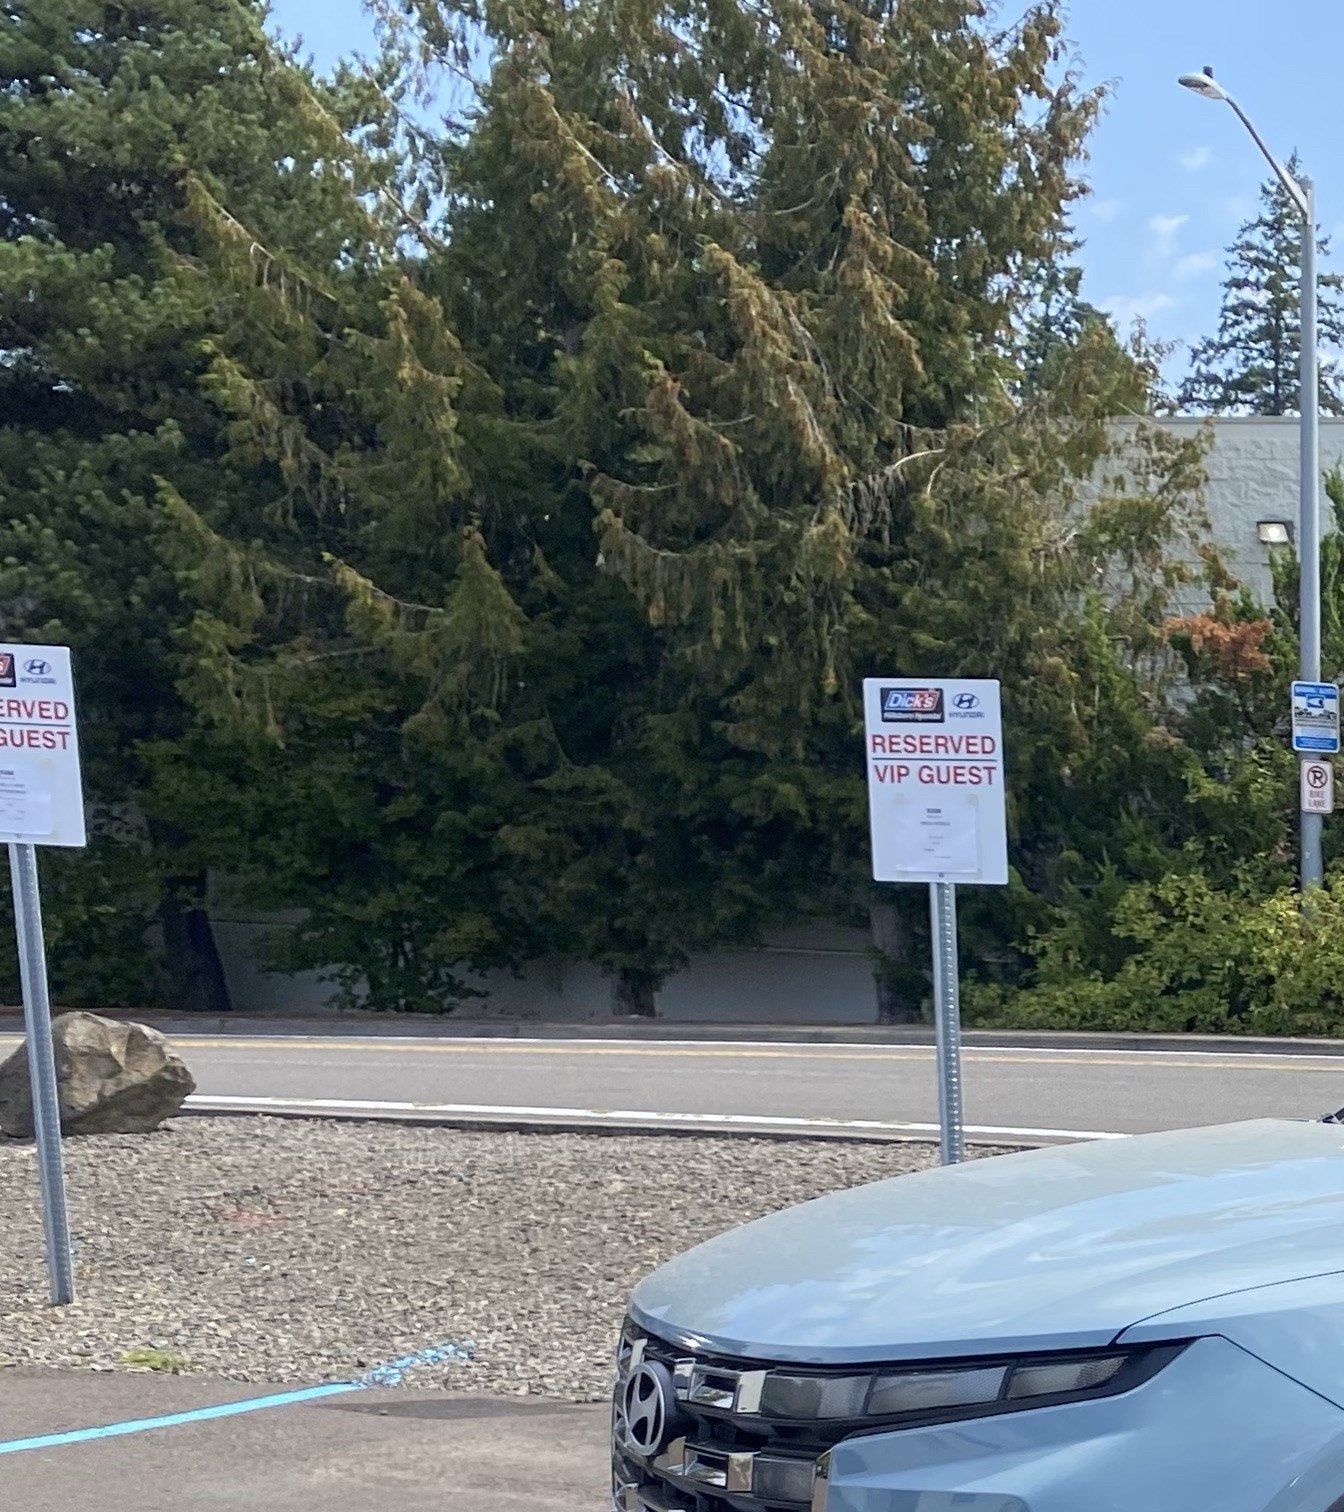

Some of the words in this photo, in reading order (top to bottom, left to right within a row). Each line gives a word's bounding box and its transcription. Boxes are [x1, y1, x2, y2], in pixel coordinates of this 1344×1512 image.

[872, 734, 995, 755] RESERVED
[874, 765, 910, 784] VIP
[918, 765, 997, 785] GUEST
